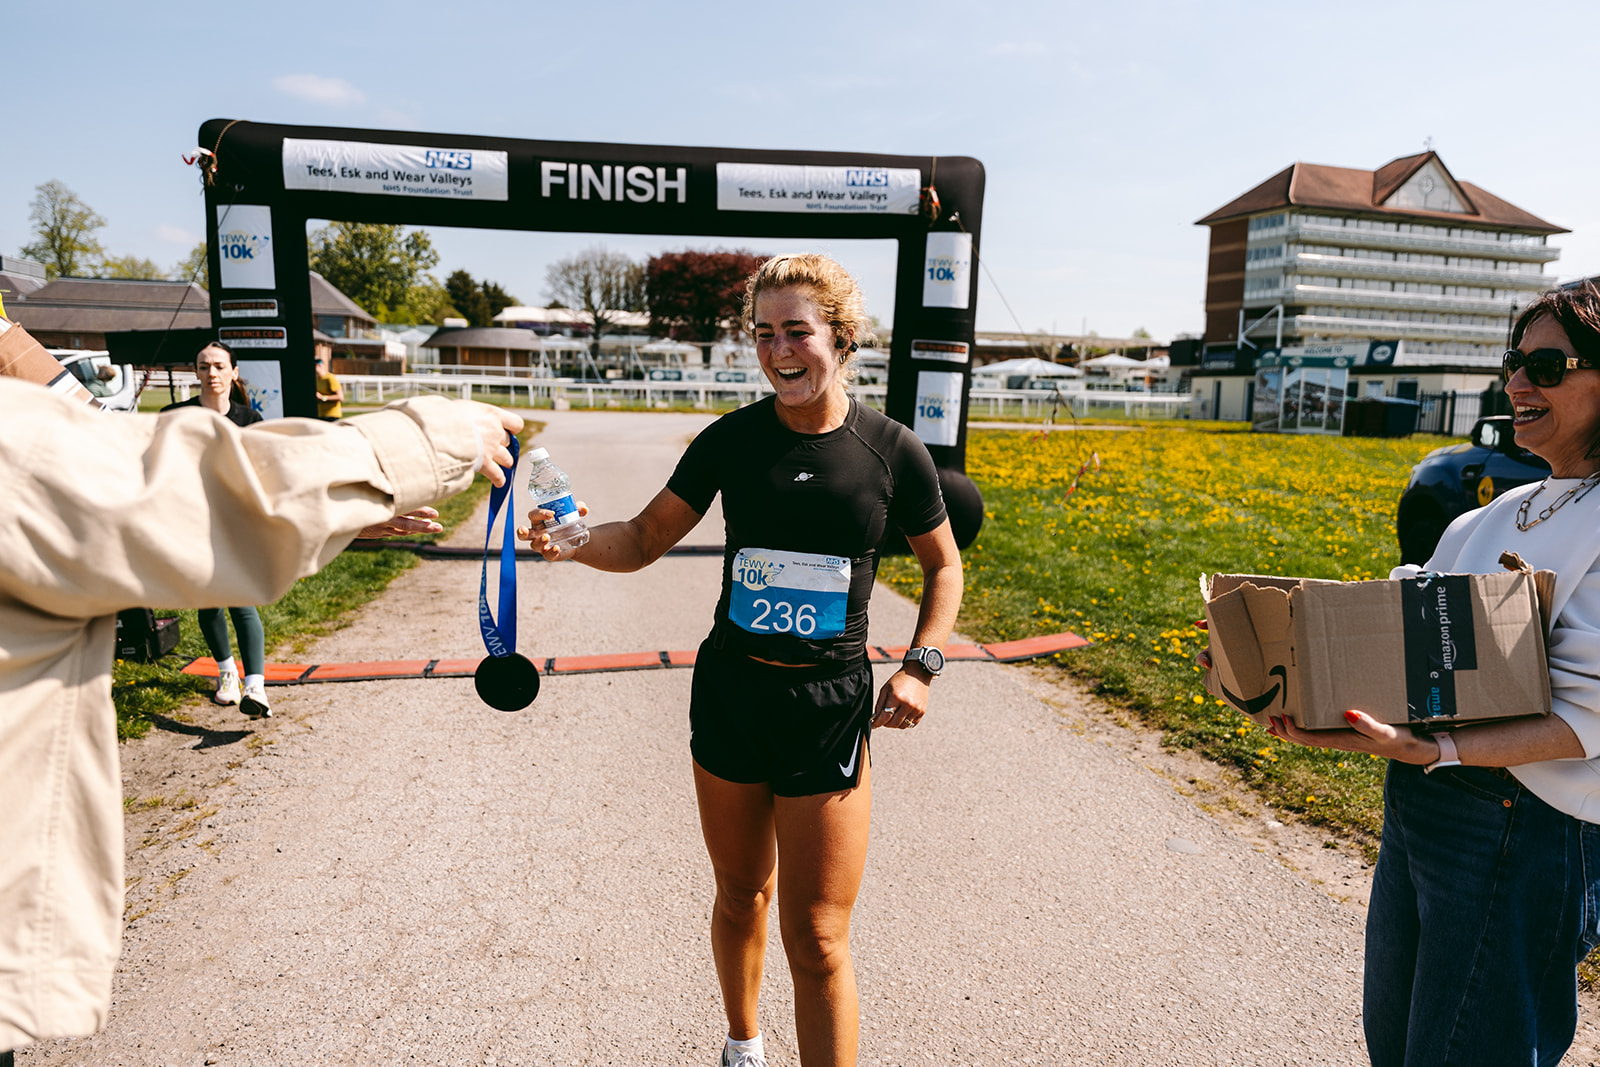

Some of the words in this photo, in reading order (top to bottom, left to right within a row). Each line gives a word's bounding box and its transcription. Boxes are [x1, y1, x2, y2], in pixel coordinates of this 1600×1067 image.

[426, 151, 472, 170] NHS
[306, 165, 337, 178] Tees,
[341, 167, 361, 178] Esk
[365, 169, 389, 180] and
[393, 170, 425, 182] Wear
[429, 172, 472, 188] Valleys
[541, 161, 686, 203] FINISH
[847, 170, 888, 187] NHS
[383, 184, 400, 192] NHS
[403, 185, 451, 194] Foundation
[453, 188, 473, 196] Trust
[738, 187, 765, 199] Tees,
[769, 188, 787, 199] Esk
[791, 190, 813, 200] and
[816, 190, 846, 200] Wear
[849, 191, 887, 203] Valleys
[221, 234, 249, 243] TEWV
[221, 244, 254, 259] 10k
[927, 267, 955, 281] 10k
[918, 405, 945, 418] 10k
[739, 557, 766, 569] TEWV
[738, 568, 769, 586] 10k
[1435, 586, 1451, 624] prime
[750, 599, 817, 635] 236
[482, 626, 509, 658] EWV
[1440, 626, 1453, 670] amazon
